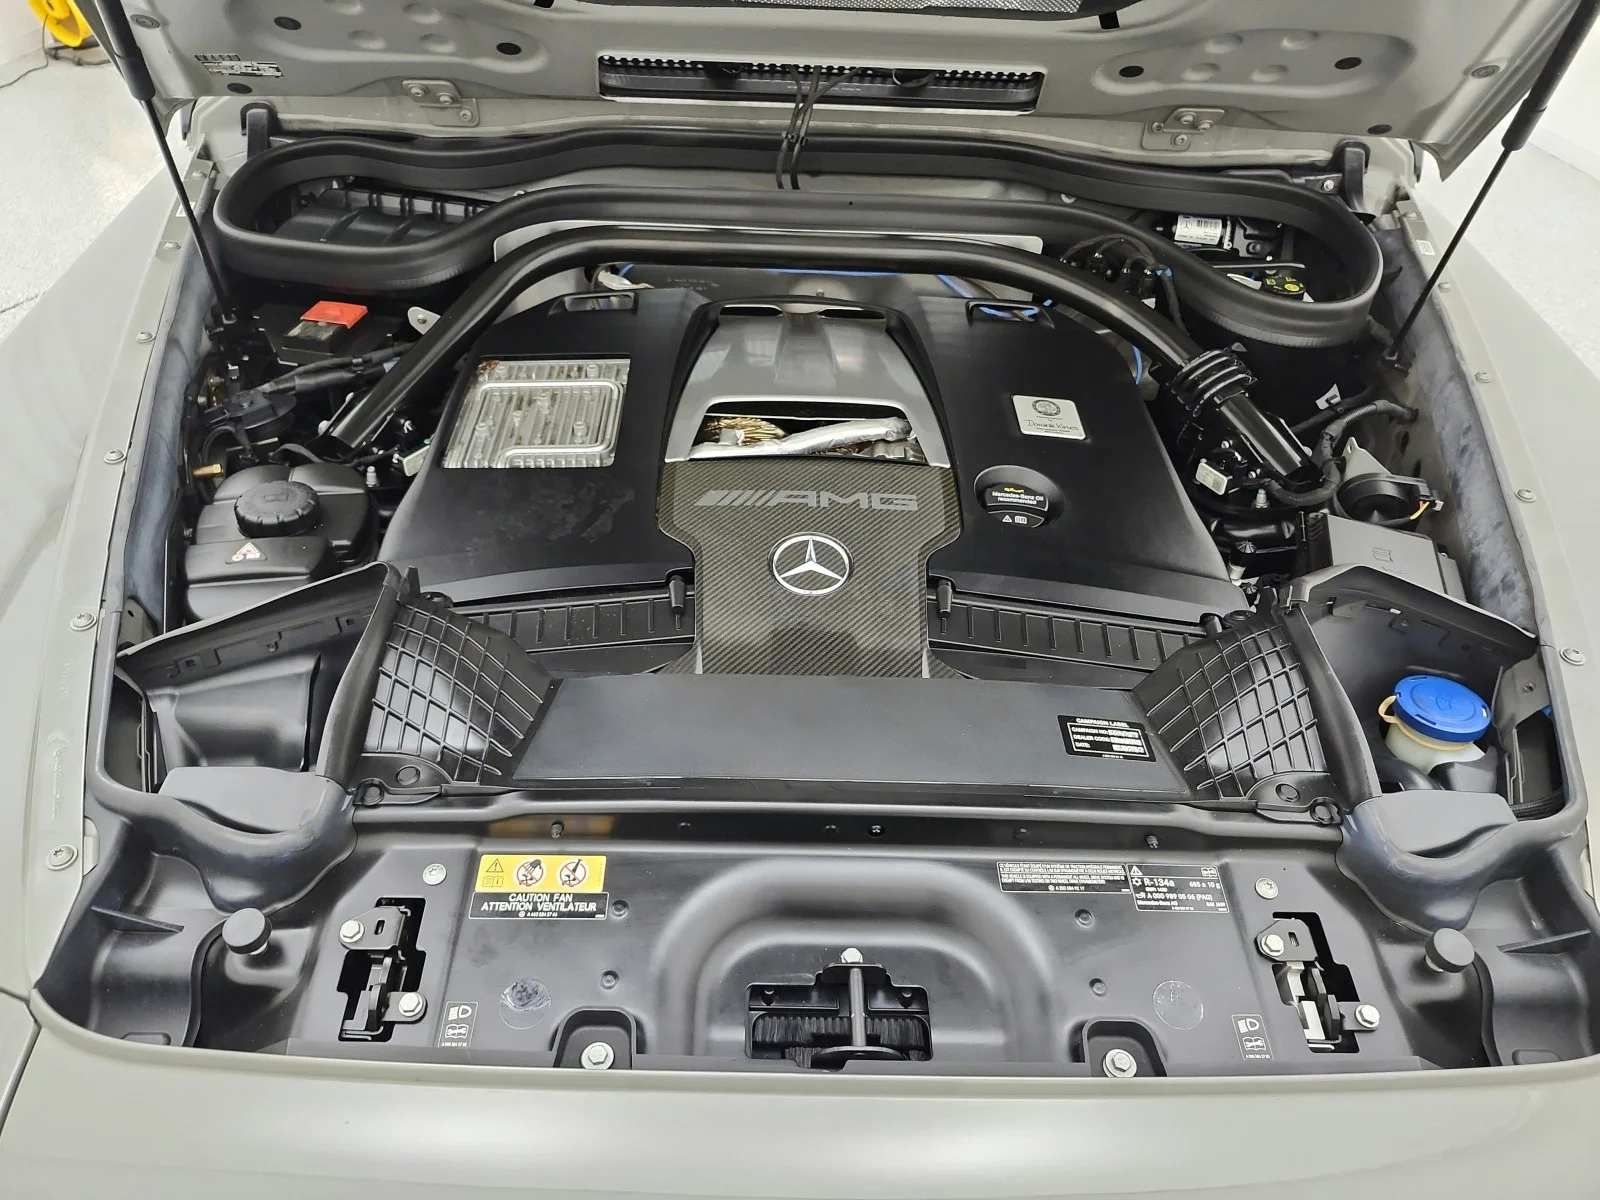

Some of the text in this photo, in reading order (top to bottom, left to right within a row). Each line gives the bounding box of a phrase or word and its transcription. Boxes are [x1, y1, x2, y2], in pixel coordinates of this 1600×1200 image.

[992, 491, 1034, 500] Mercedes-Benz
[774, 490, 918, 511] AMG
[1144, 878, 1175, 887] R-134a
[509, 894, 573, 902] CAUTION FAN
[481, 902, 596, 912] ATTENTION VENTILATEUR
